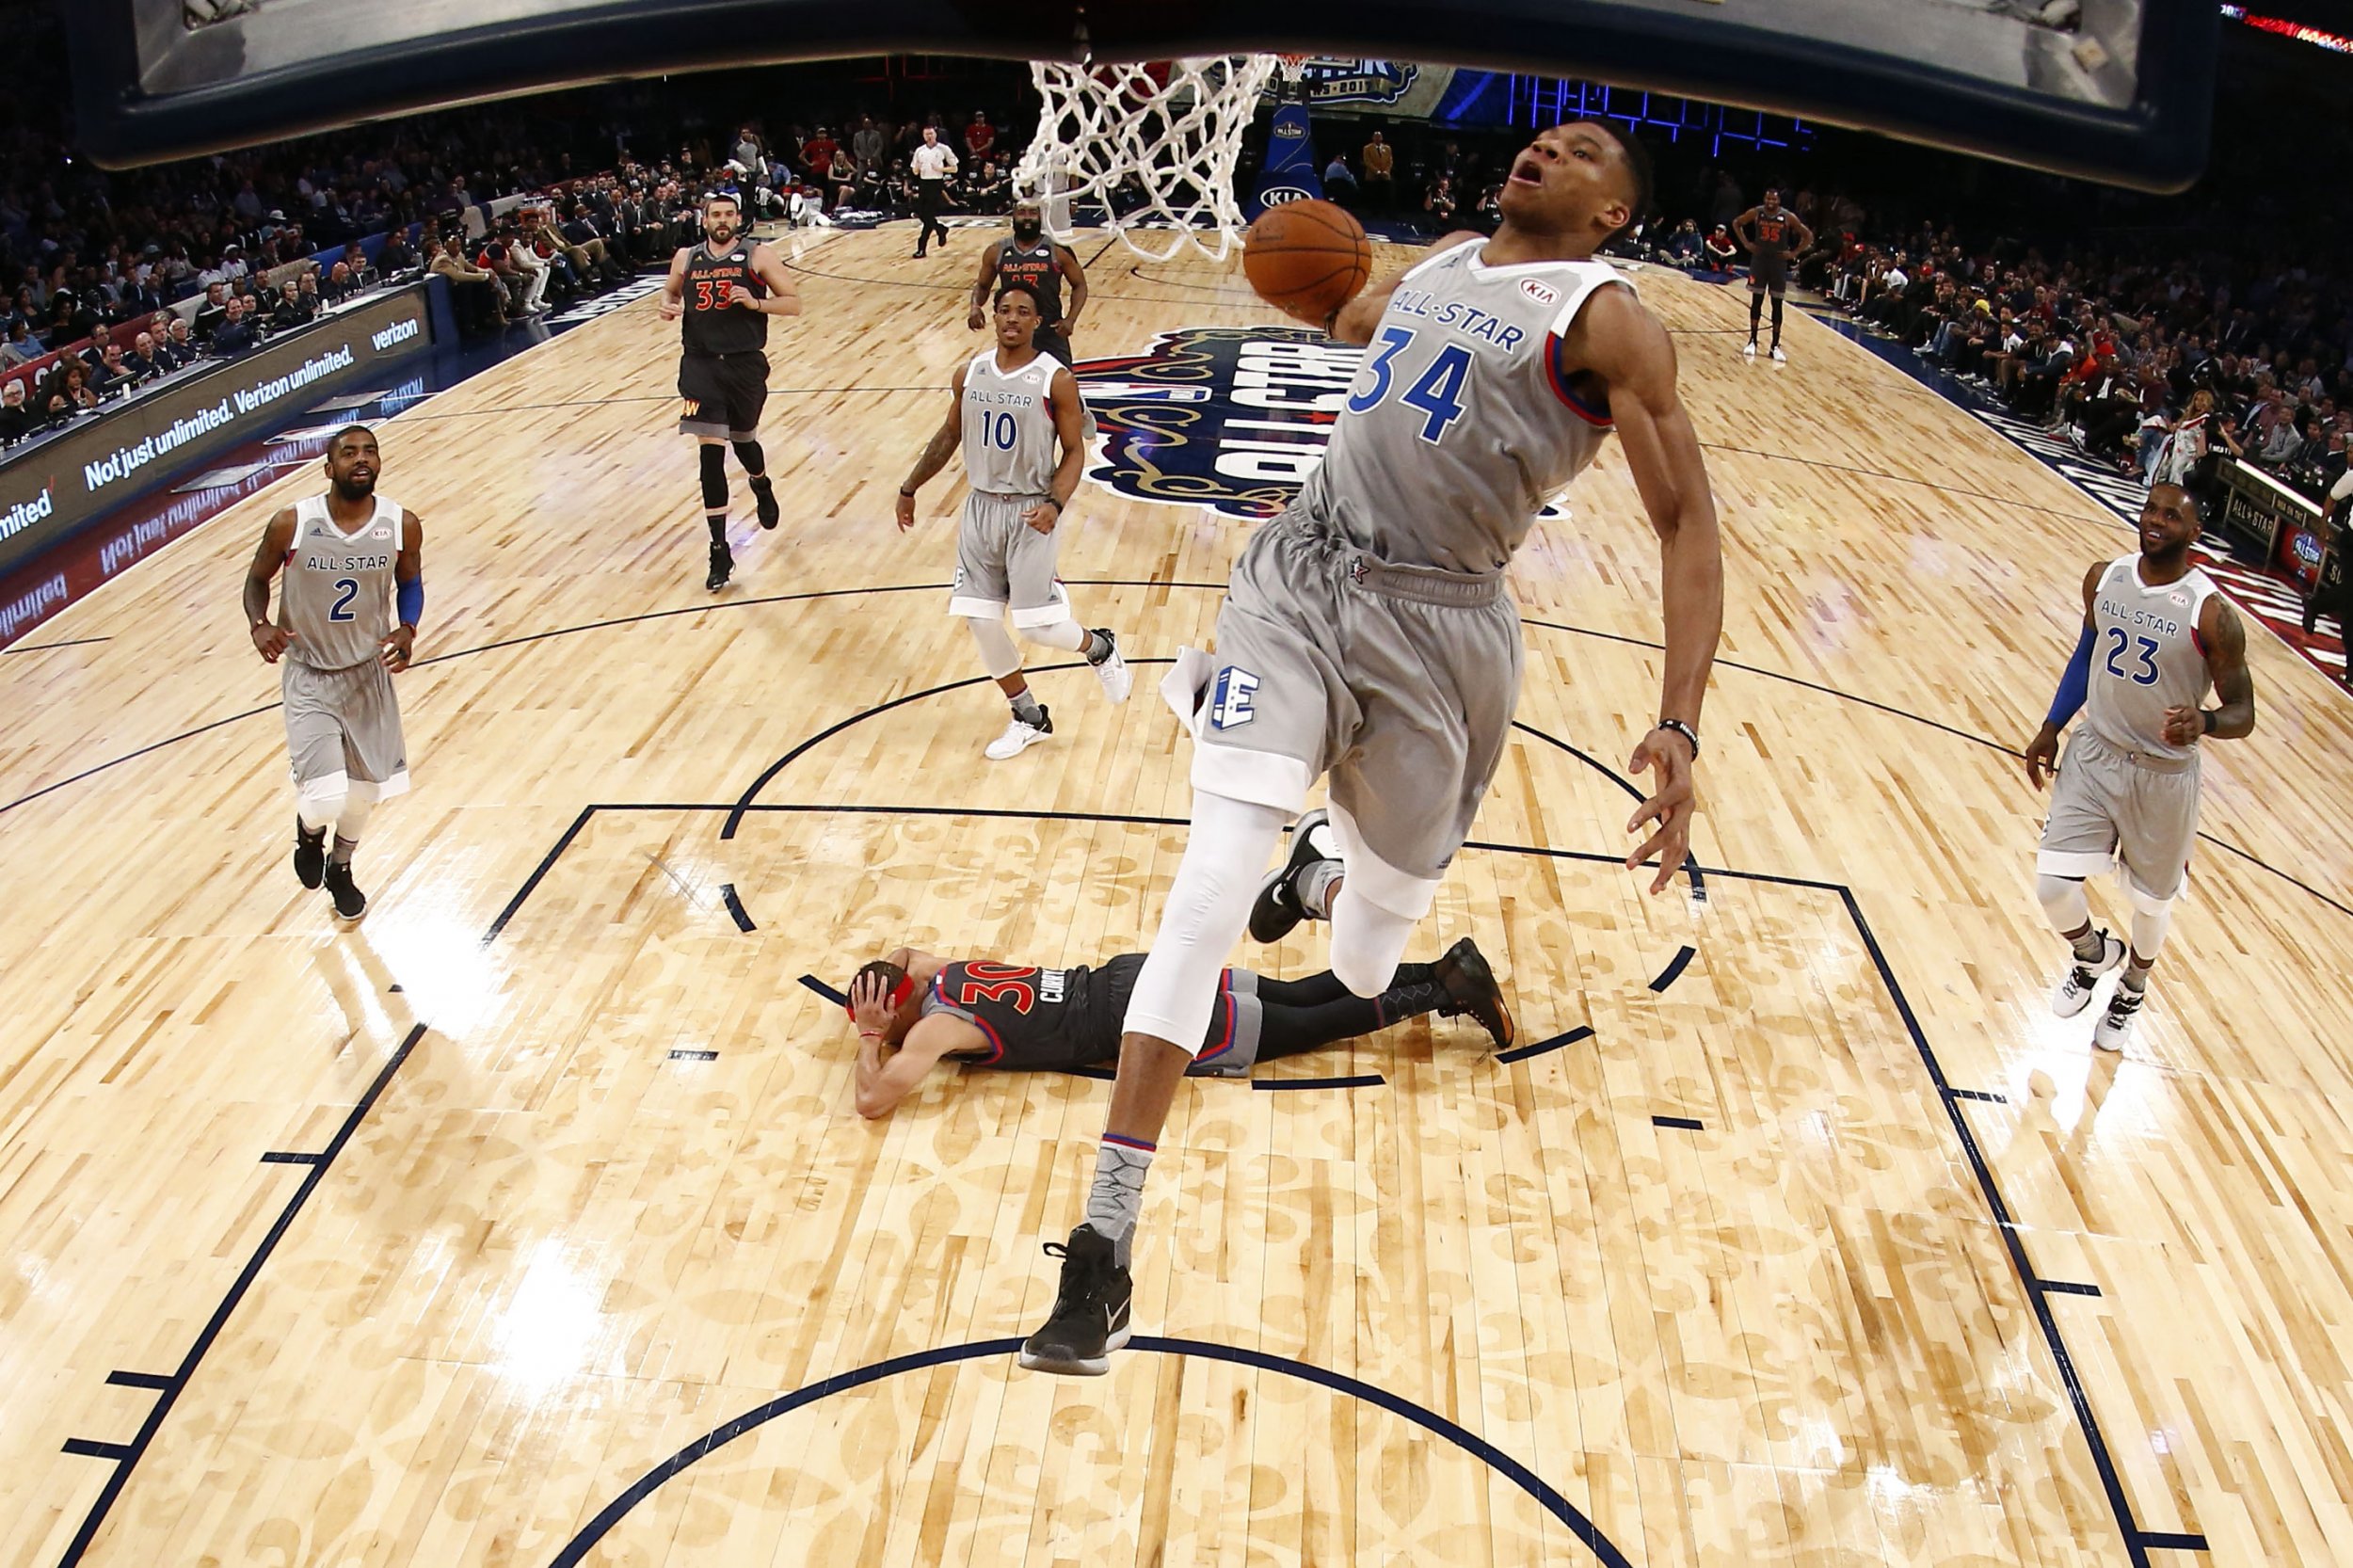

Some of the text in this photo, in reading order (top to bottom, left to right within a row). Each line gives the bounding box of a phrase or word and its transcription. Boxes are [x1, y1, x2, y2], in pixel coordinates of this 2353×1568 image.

[1270, 192, 1303, 204] KIA
[695, 280, 734, 311] 33
[1525, 282, 1554, 303] KIA
[372, 318, 418, 352] verizon
[1346, 324, 1477, 446] 34
[84, 453, 121, 491] Not
[120, 436, 156, 479] just
[155, 398, 234, 455] unlimited.
[233, 374, 291, 415] Verizon
[289, 344, 354, 391] unlimited.
[982, 408, 1018, 452] 10
[328, 578, 360, 623] 2
[2105, 626, 2161, 687] 23
[961, 960, 1037, 1016] 30
[1039, 968, 1065, 1003] CURRY
